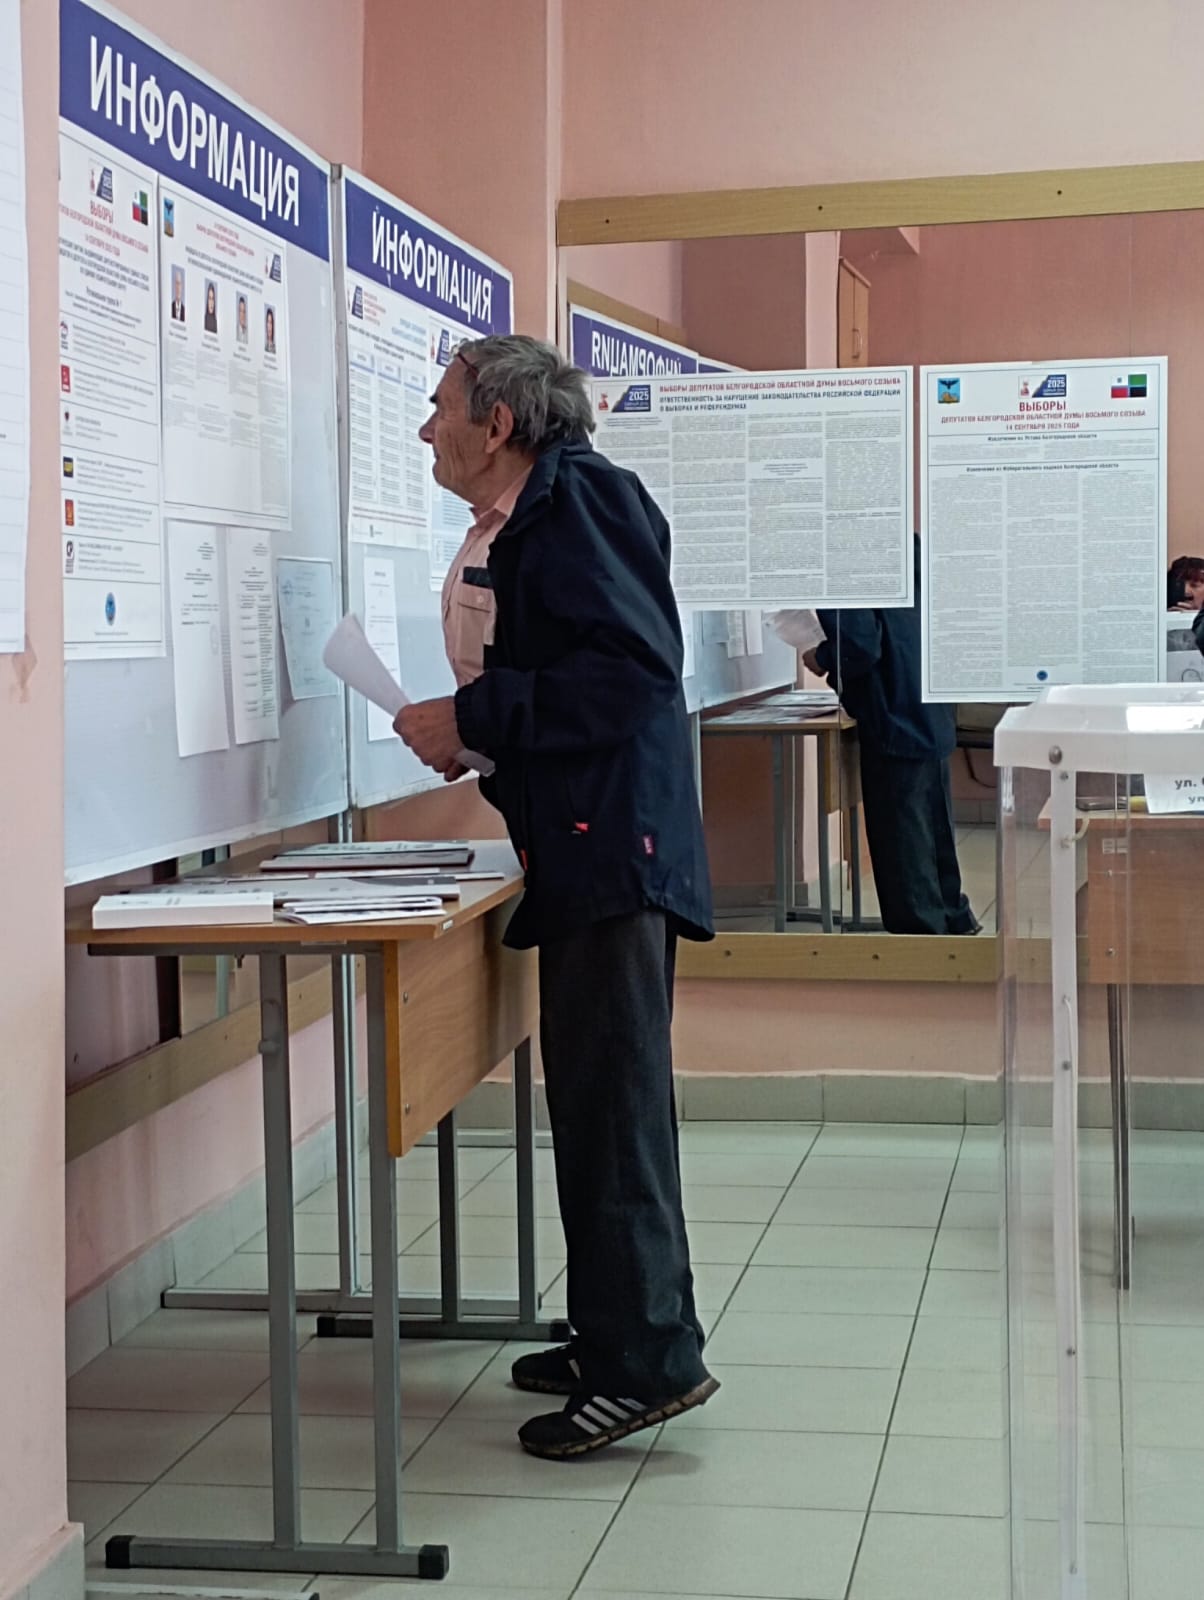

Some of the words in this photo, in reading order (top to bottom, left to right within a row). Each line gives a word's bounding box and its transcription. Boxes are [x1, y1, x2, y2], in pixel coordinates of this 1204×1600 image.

[90, 35, 300, 227] ИНФОРМАЦИЯ
[372, 211, 493, 325] ИНФОРМАЦИЯ
[659, 384, 688, 393] ВЫБОРЫ
[689, 383, 724, 393] ДЕПУТАТОВ
[725, 381, 776, 391] БЕЛГОРОДСКОЙ
[777, 379, 815, 389] ОБЛАСТНОЙ
[816, 379, 837, 388] ДУМЫ
[838, 378, 873, 387] ВОСЬМОГО
[874, 377, 901, 386] СОЗЫВА
[1047, 379, 1066, 389] 2025
[629, 391, 649, 401] 2025
[1019, 400, 1067, 412] ВЫБОРЫ
[1063, 421, 1080, 430] ГОДА
[1174, 780, 1198, 791] ул.
